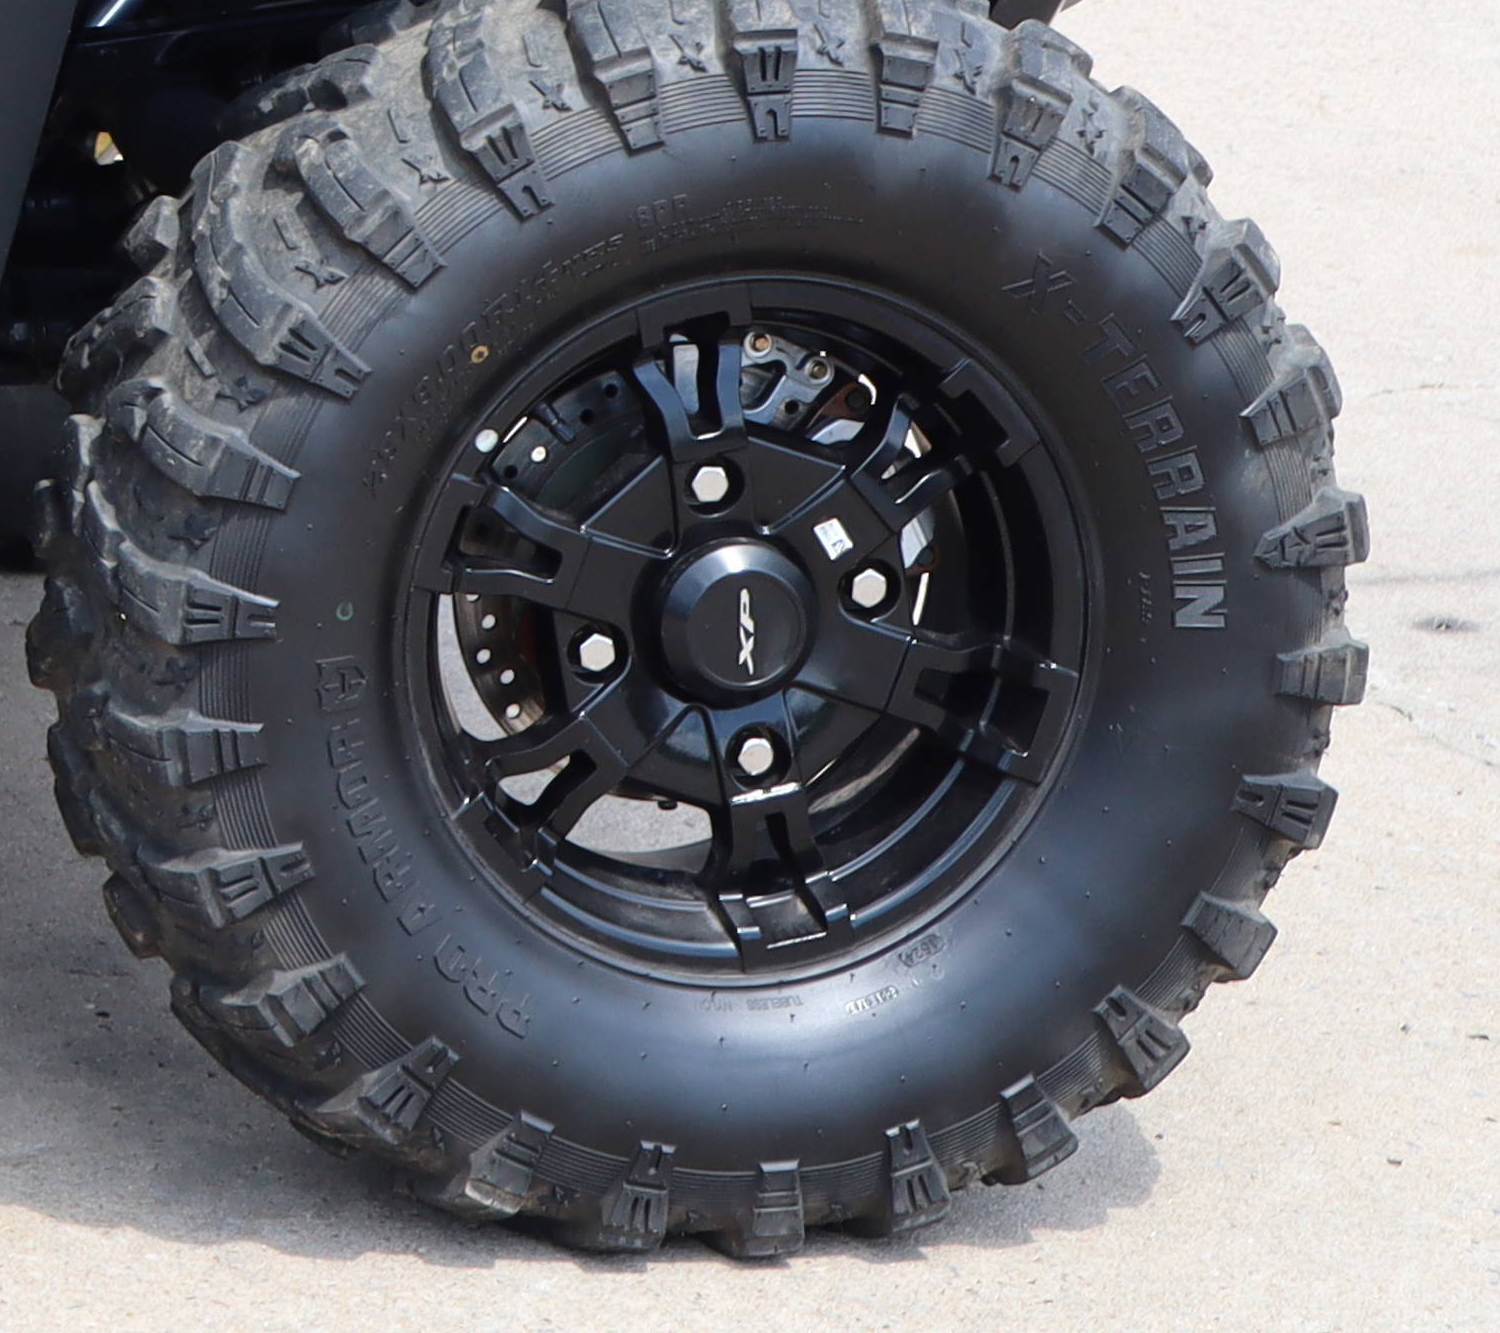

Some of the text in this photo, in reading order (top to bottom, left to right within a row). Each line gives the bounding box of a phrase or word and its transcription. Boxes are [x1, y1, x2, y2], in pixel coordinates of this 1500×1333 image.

[1001, 250, 1228, 629] X-TERRAIN
[738, 587, 755, 676] XP
[326, 717, 532, 1040] PRO ARMOR
